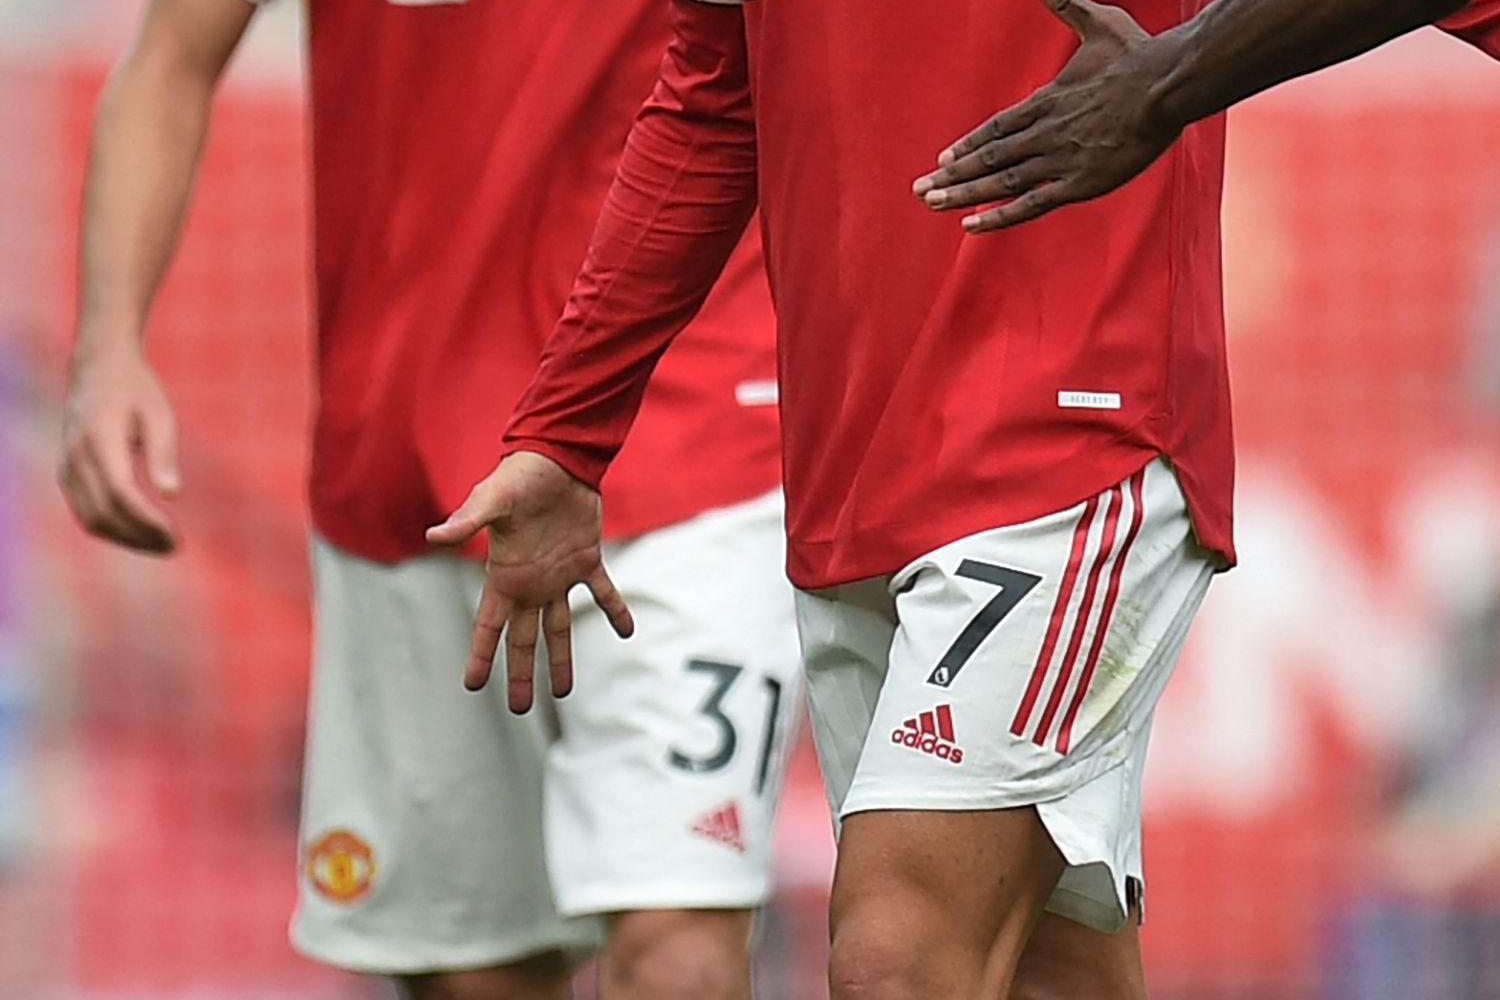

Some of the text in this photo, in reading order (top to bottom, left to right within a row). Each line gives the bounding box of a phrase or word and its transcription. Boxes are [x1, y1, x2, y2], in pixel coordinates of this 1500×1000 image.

[926, 557, 1044, 689] 7
[669, 658, 781, 799] 31
[890, 728, 965, 765] adidas
